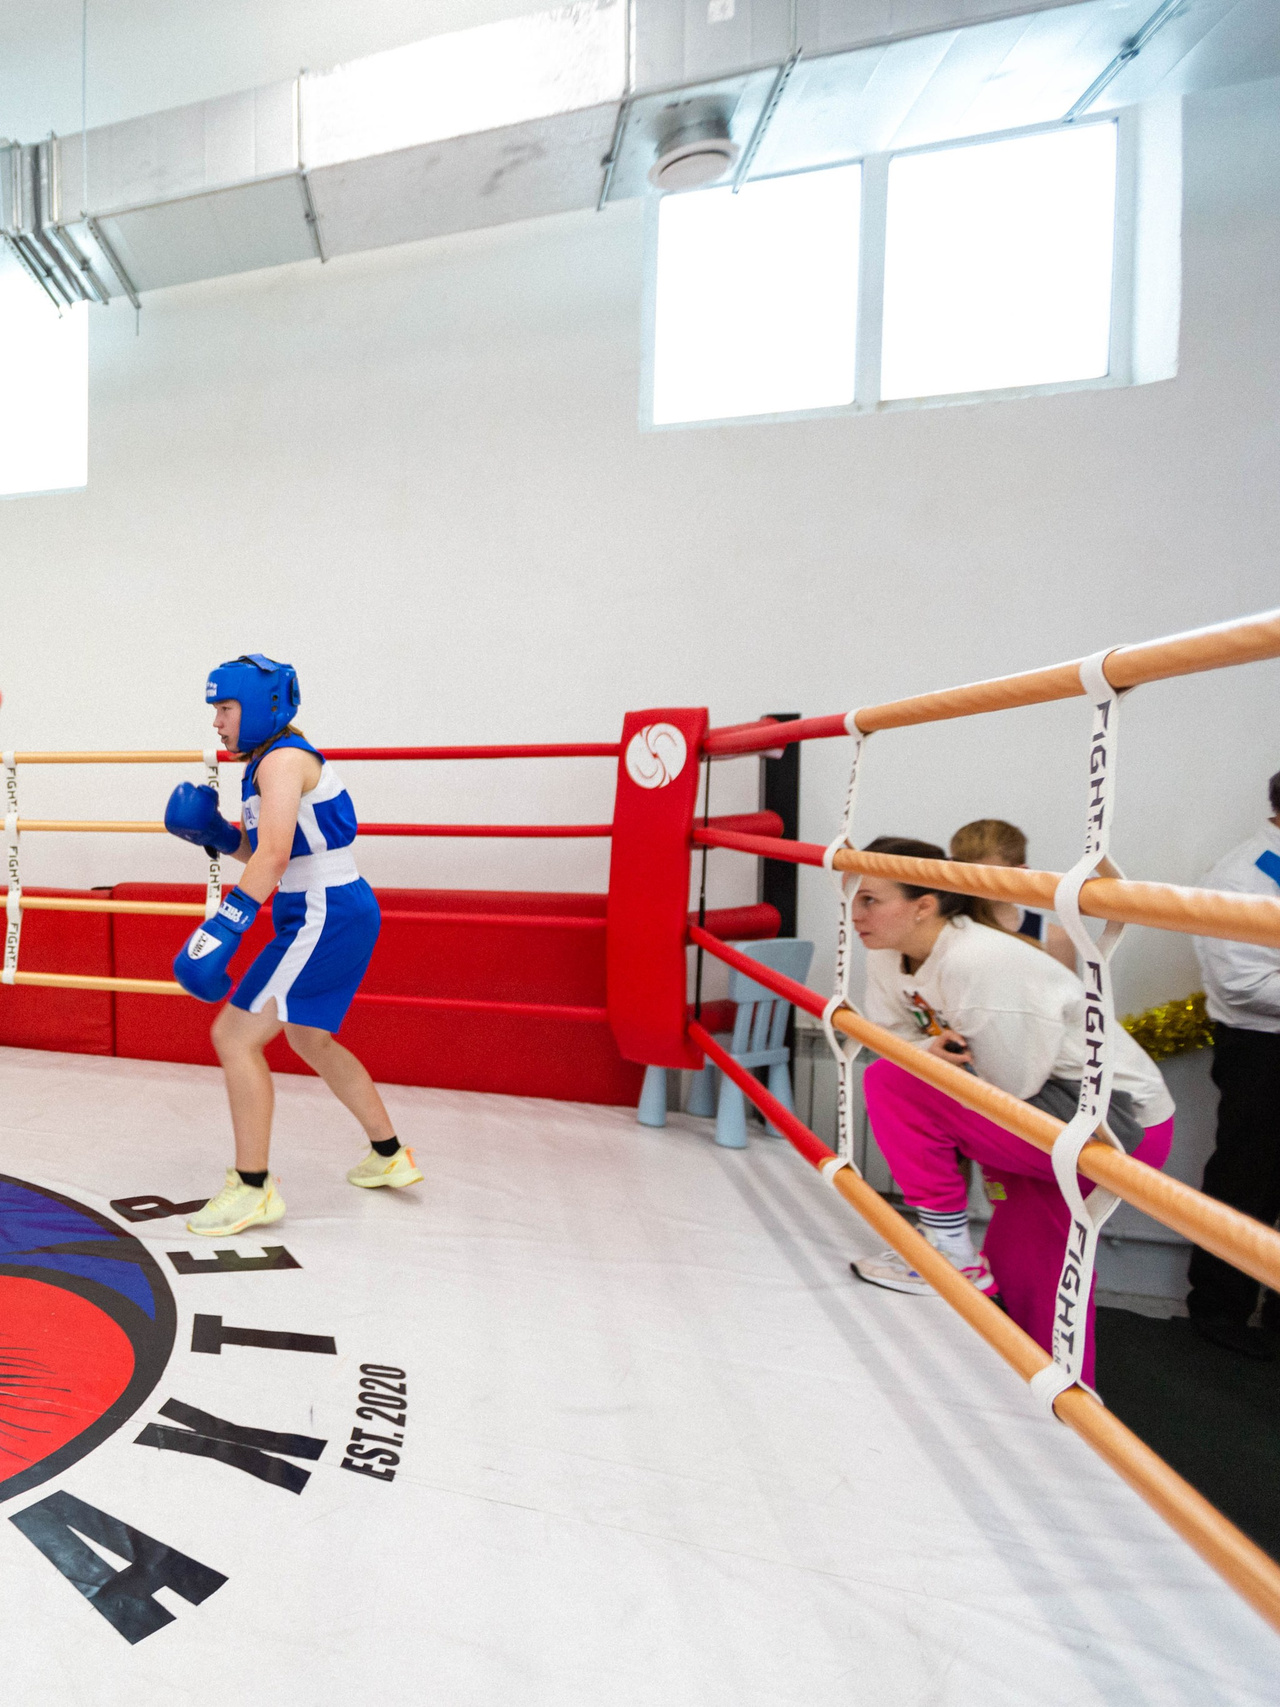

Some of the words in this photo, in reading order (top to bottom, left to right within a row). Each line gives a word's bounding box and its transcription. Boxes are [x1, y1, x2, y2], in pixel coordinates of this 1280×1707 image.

[6, 767, 18, 806] FIGHT
[1090, 699, 1112, 830] FIGHT
[9, 846, 20, 884] FIGHT
[7, 922, 19, 962] FIGHT
[1086, 961, 1104, 1095] FIGHT
[1058, 1220, 1087, 1355] FIGHT
[356, 1363, 407, 1427] 2020
[340, 1426, 404, 1482] EST.
